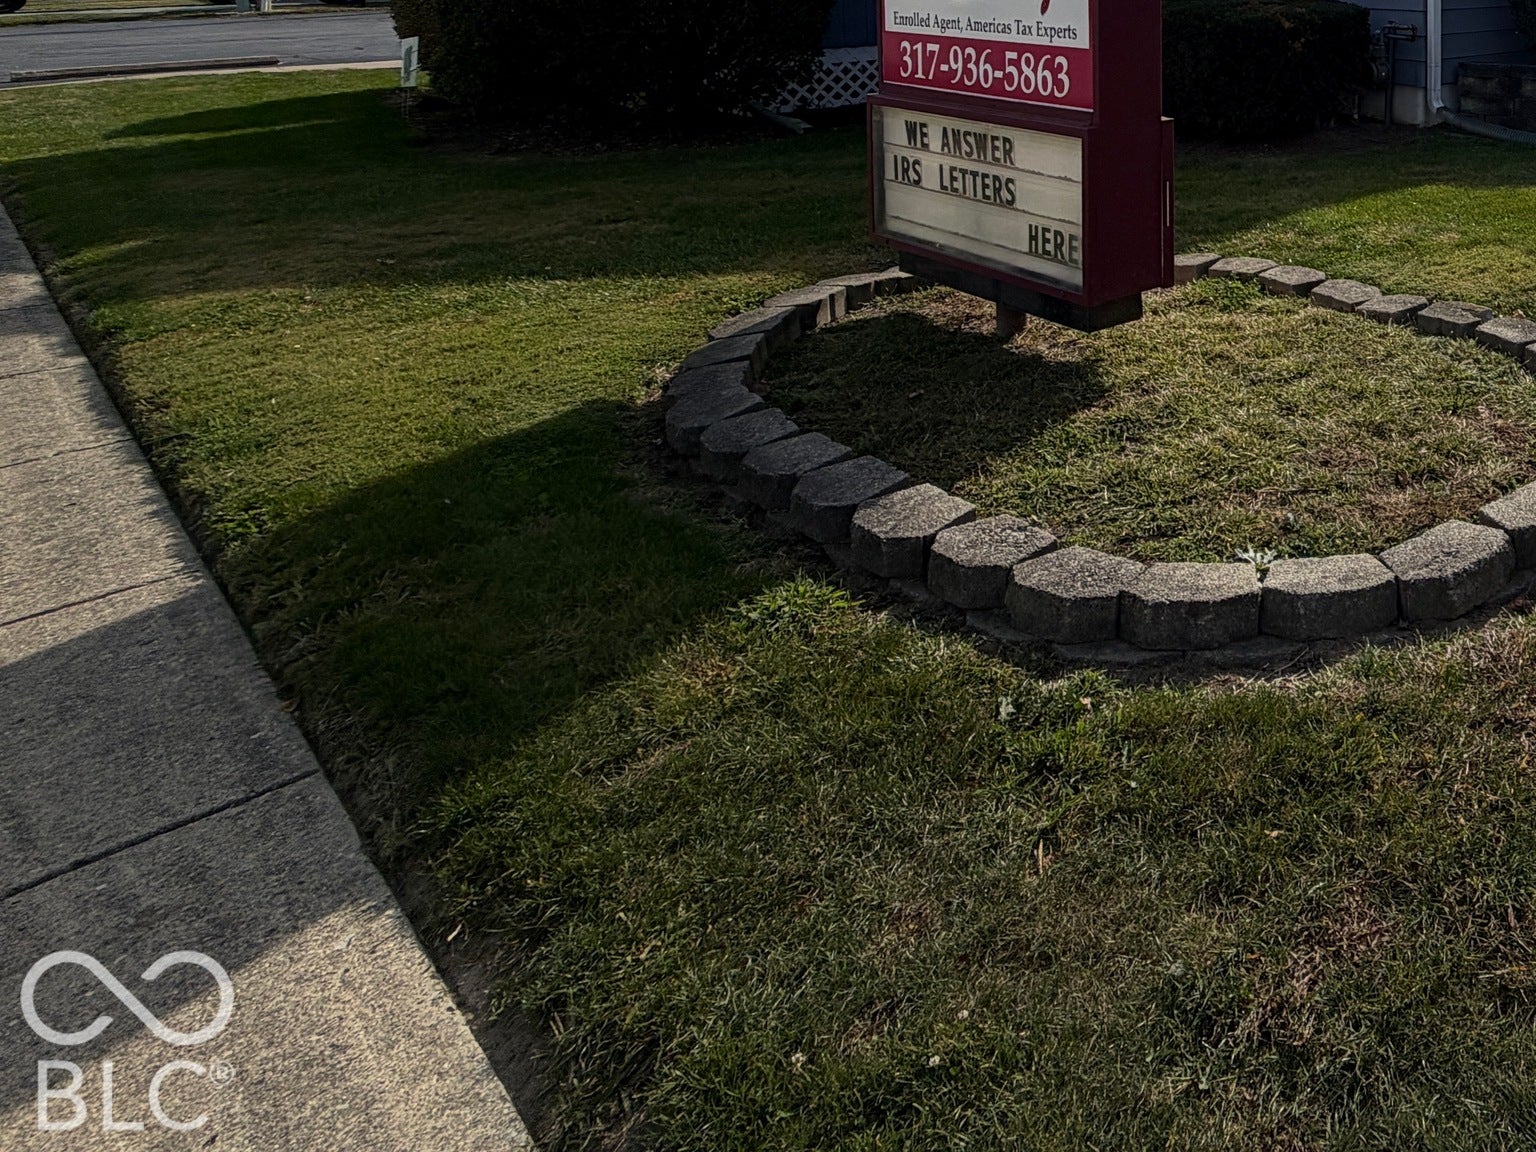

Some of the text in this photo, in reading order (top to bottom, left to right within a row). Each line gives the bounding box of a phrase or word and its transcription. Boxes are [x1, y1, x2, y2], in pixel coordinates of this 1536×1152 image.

[893, 11, 1078, 43] Enrolled Agent, Americas Tax Experts
[899, 40, 1070, 98] 317-936-5863
[905, 120, 1015, 166] WE ANSWER
[894, 154, 1016, 207] IRS LETTERS
[1028, 223, 1081, 266] HERE
